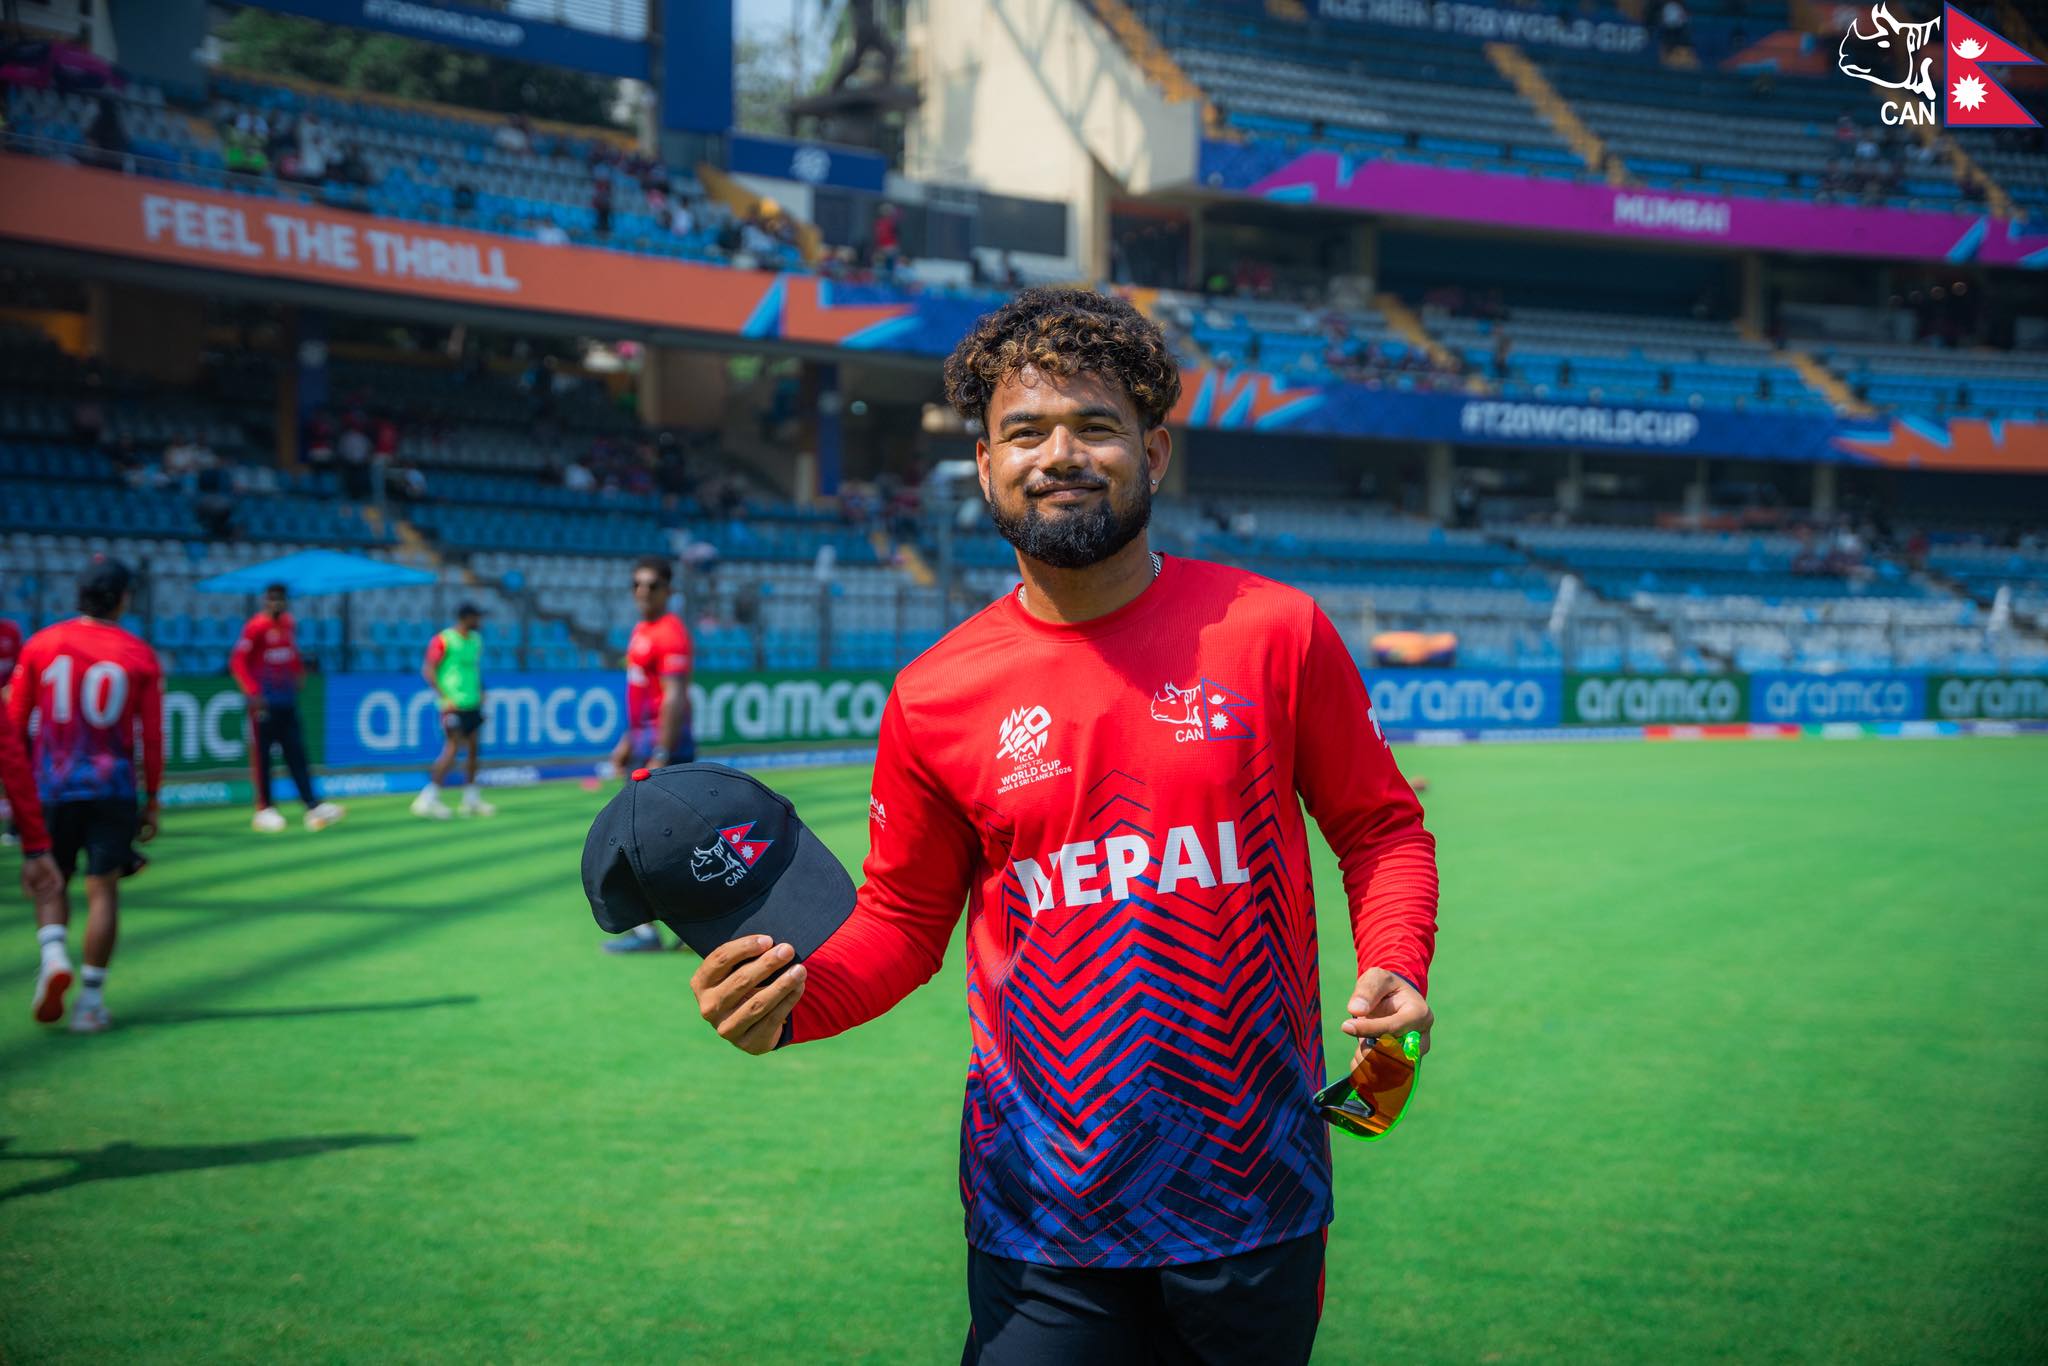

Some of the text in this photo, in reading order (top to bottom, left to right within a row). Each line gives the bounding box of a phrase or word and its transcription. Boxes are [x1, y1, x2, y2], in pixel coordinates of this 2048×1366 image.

[1500, 11, 1593, 47] WORLD
[1596, 21, 1648, 51] CUP
[1614, 194, 1731, 235] MUMBAI
[143, 194, 521, 292] FEEL THE THRILL
[1461, 401, 1699, 446] #T20WORLDCUP
[41, 654, 129, 729] 10
[1372, 680, 1544, 721] aramco
[1577, 678, 1740, 722] aramco
[1765, 680, 1910, 717] aramco
[357, 687, 618, 749] armco
[1176, 727, 1204, 743] CAN
[1000, 759, 1061, 786] WORLD CUP
[1019, 752, 1035, 763] ICC
[1032, 758, 1043, 767] T20
[997, 784, 1014, 795] INDIA
[1019, 778, 1030, 787] SRI
[1030, 770, 1055, 783] LANKA
[1055, 766, 1073, 776] 2026
[725, 865, 747, 887] CAN
[1013, 820, 1250, 918] NEPAL
